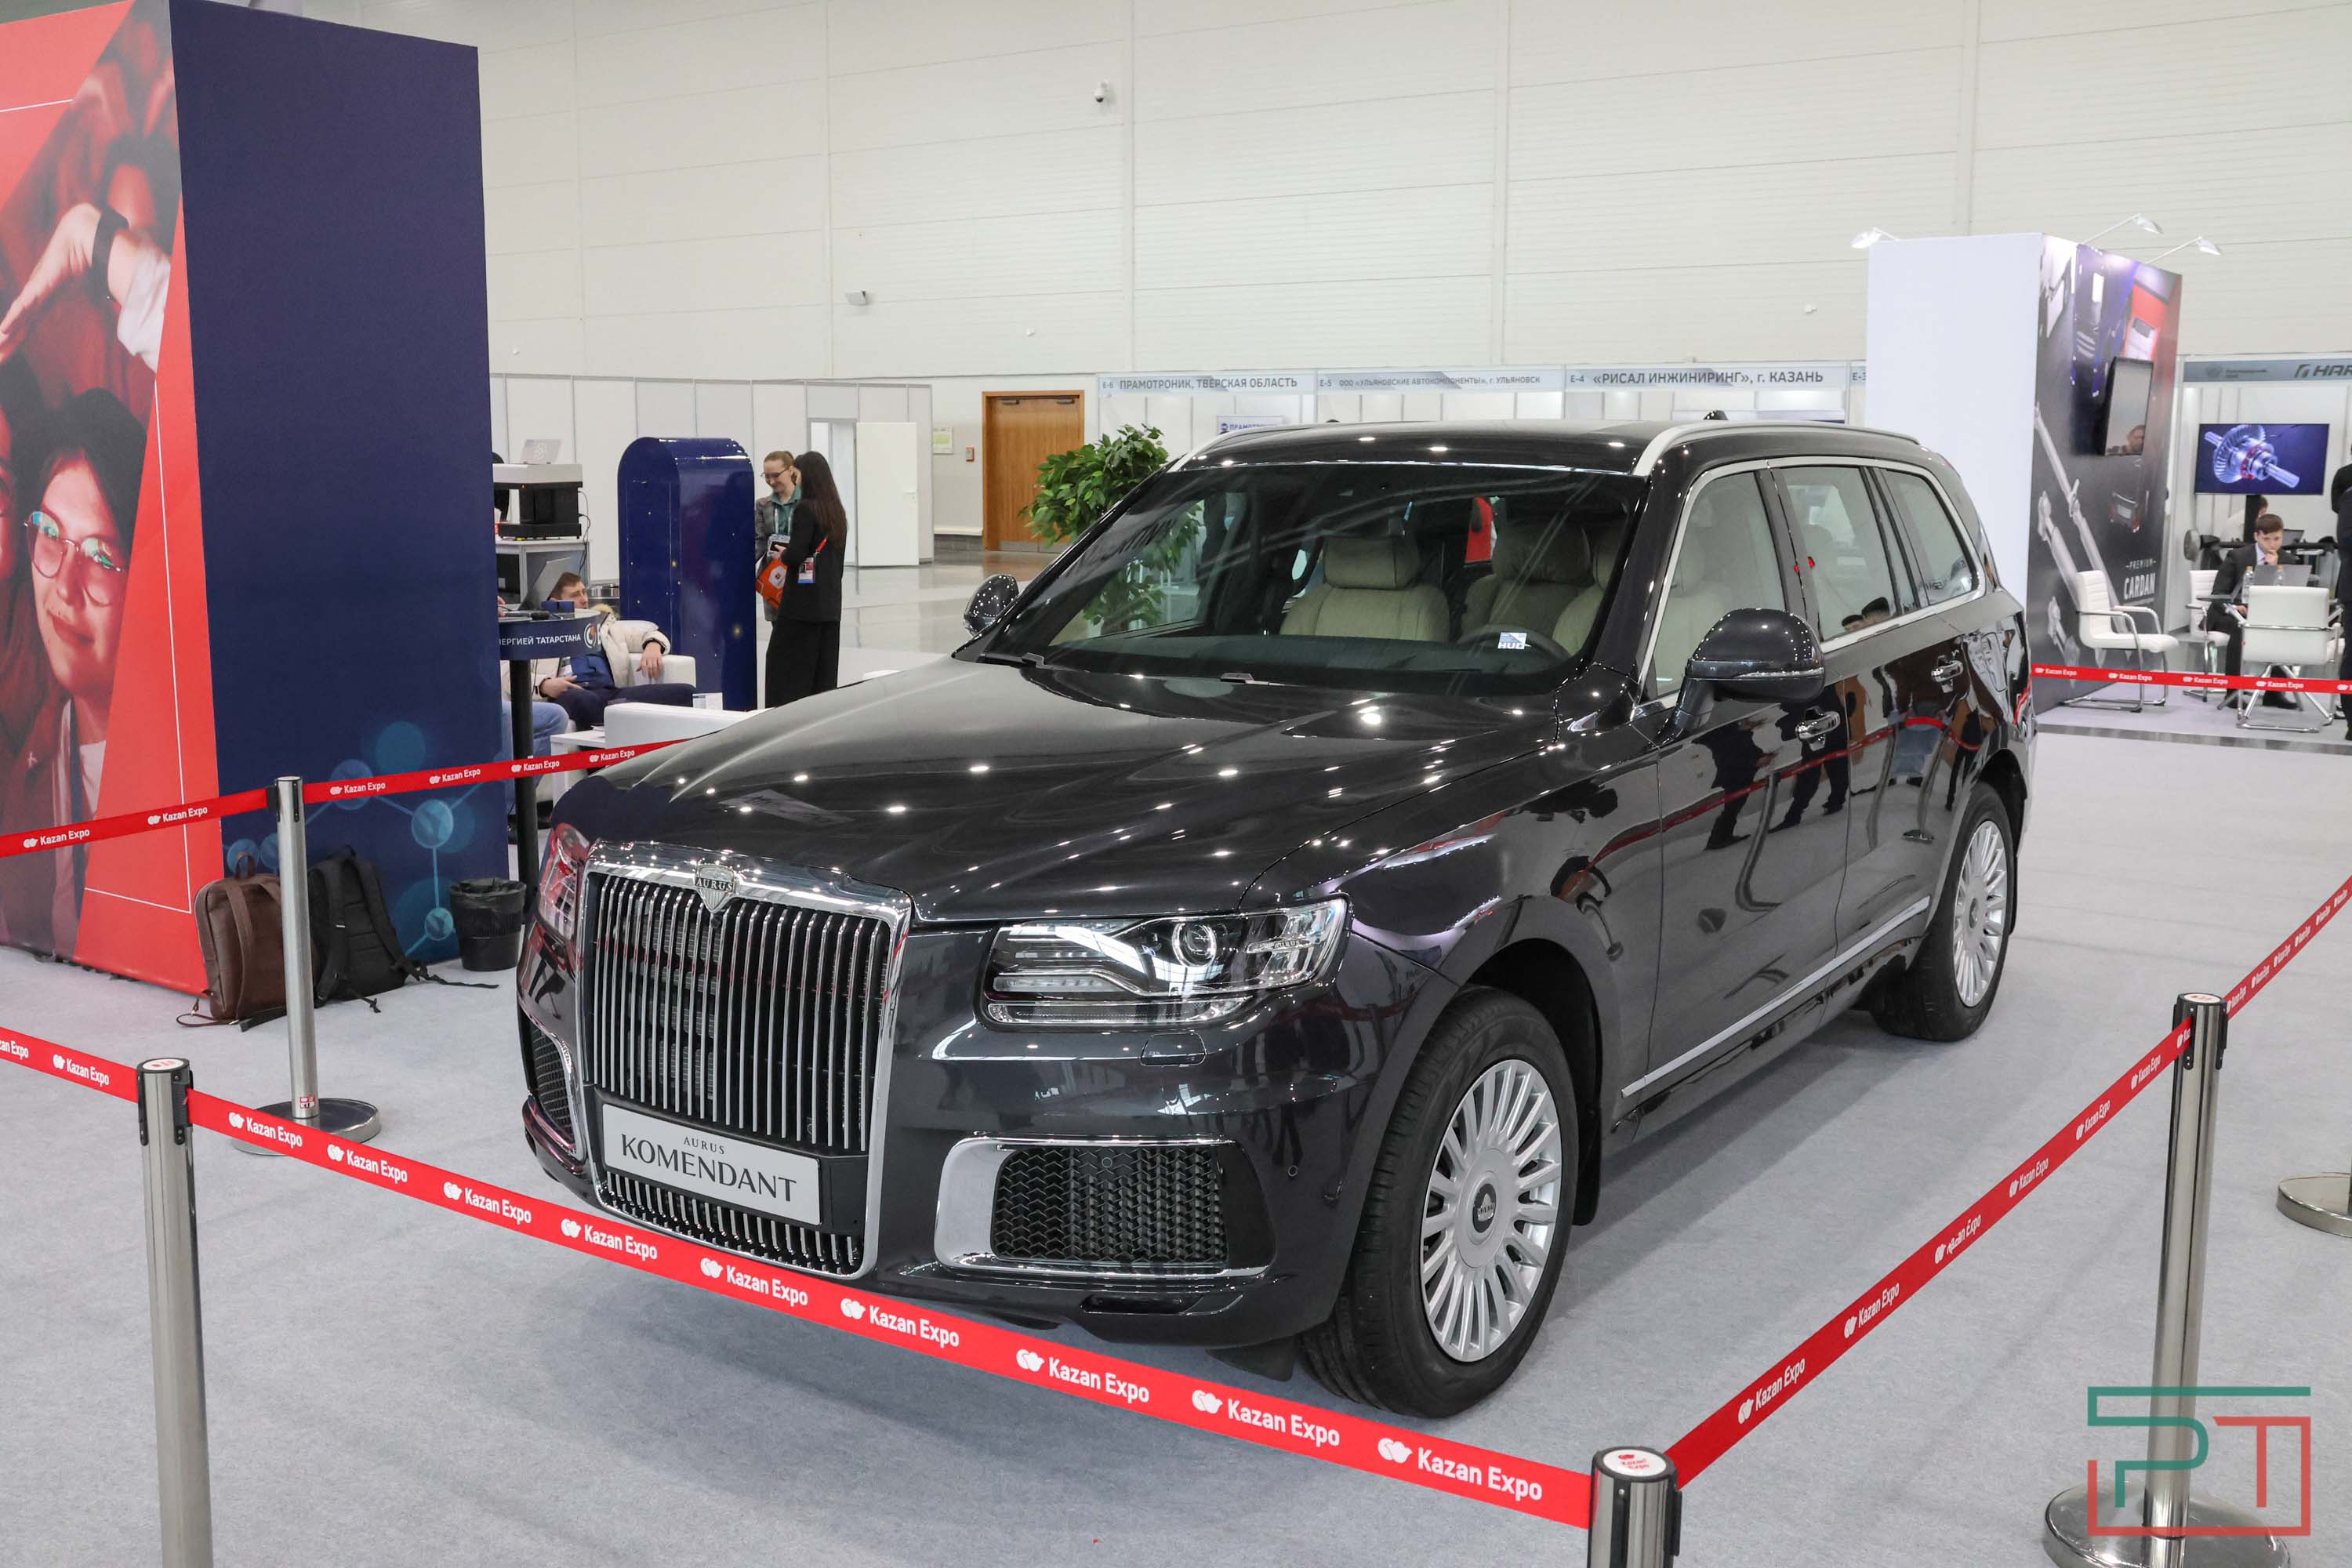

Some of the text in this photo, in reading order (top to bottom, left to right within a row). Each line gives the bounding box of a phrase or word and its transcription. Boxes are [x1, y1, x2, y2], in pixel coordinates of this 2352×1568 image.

[1120, 379, 1194, 390] ПРАМОТРОНИК,
[1196, 378, 1247, 388] ТВЕРСКАЯ
[1250, 377, 1298, 387] ОБЛАСТЬ
[1593, 373, 1645, 384] «РИСАЛ
[1649, 372, 1753, 384] ИНЖИНИРИНГ»,
[1769, 372, 1824, 383] КАЗАНЬ
[2124, 572, 2156, 600] CARDAN
[536, 633, 581, 644] ТАТАРСТАНА
[2063, 670, 2078, 680] Expo
[2138, 675, 2153, 684] Expo
[524, 760, 560, 773] Kazan Expo
[601, 750, 635, 762] Kazan Expo
[343, 782, 386, 795] Kazan Expo
[442, 768, 481, 783] Kazan Expo
[162, 807, 208, 824] Kazan Expo
[40, 829, 90, 848] Kazan Expo
[696, 877, 732, 891] AURUS
[11, 1040, 29, 1060] Expo
[66, 1058, 110, 1087] Kazan Expo
[2138, 1054, 2161, 1083] Kazan Expo
[2083, 1099, 2111, 1134] Kazan Expo
[246, 1116, 303, 1149] Kazan Expo
[684, 1136, 725, 1155] AURUS
[347, 1149, 408, 1184] Kazan Expo
[622, 1134, 797, 1202] KOMENDANT
[2019, 1157, 2049, 1191] Kazan Expo
[464, 1188, 532, 1225] Kazan Expo
[1965, 1214, 1981, 1237] Expo
[584, 1224, 658, 1261] Kazan Expo
[726, 1265, 808, 1307] Kazan Expo
[1858, 1283, 1900, 1329] Kazan Expo
[869, 1305, 960, 1348] Kazan Expo
[1049, 1356, 1149, 1404] Kazan Expo
[1755, 1358, 1806, 1411] Kazan Expo
[1228, 1398, 1340, 1447] Kazan Expo
[1417, 1446, 1543, 1501] Kazan Expo
